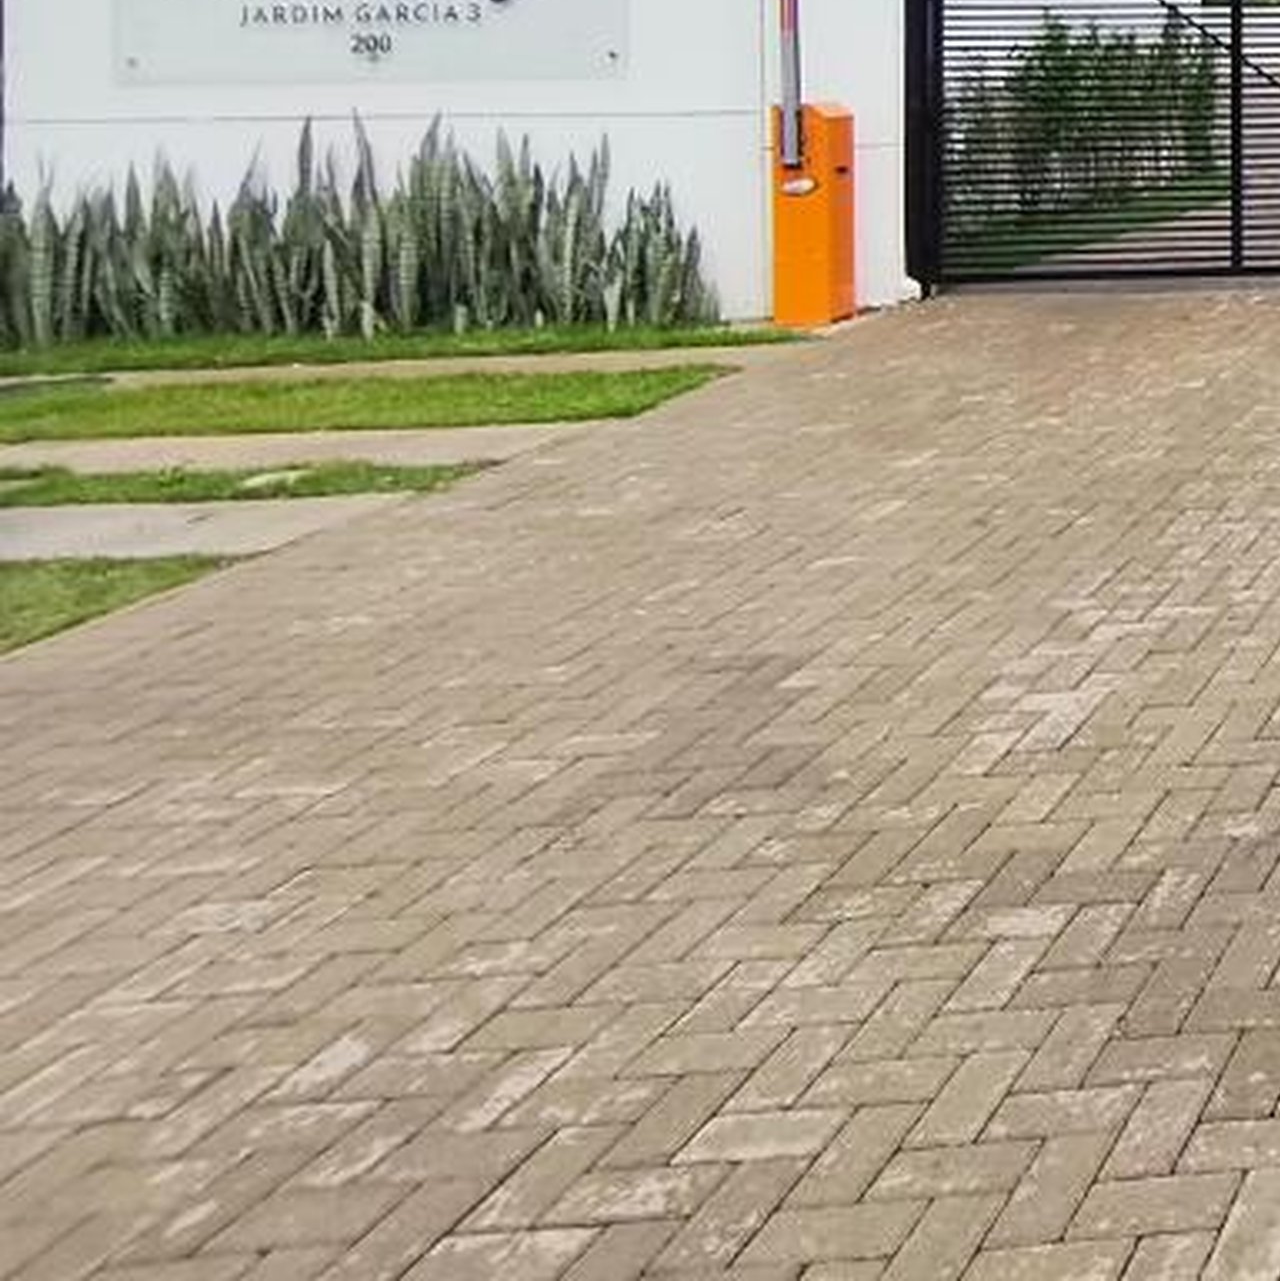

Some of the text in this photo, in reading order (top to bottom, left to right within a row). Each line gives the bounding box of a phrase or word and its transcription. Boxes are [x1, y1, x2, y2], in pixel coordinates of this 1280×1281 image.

[239, 2, 481, 26] JARDIM GARCIA 3
